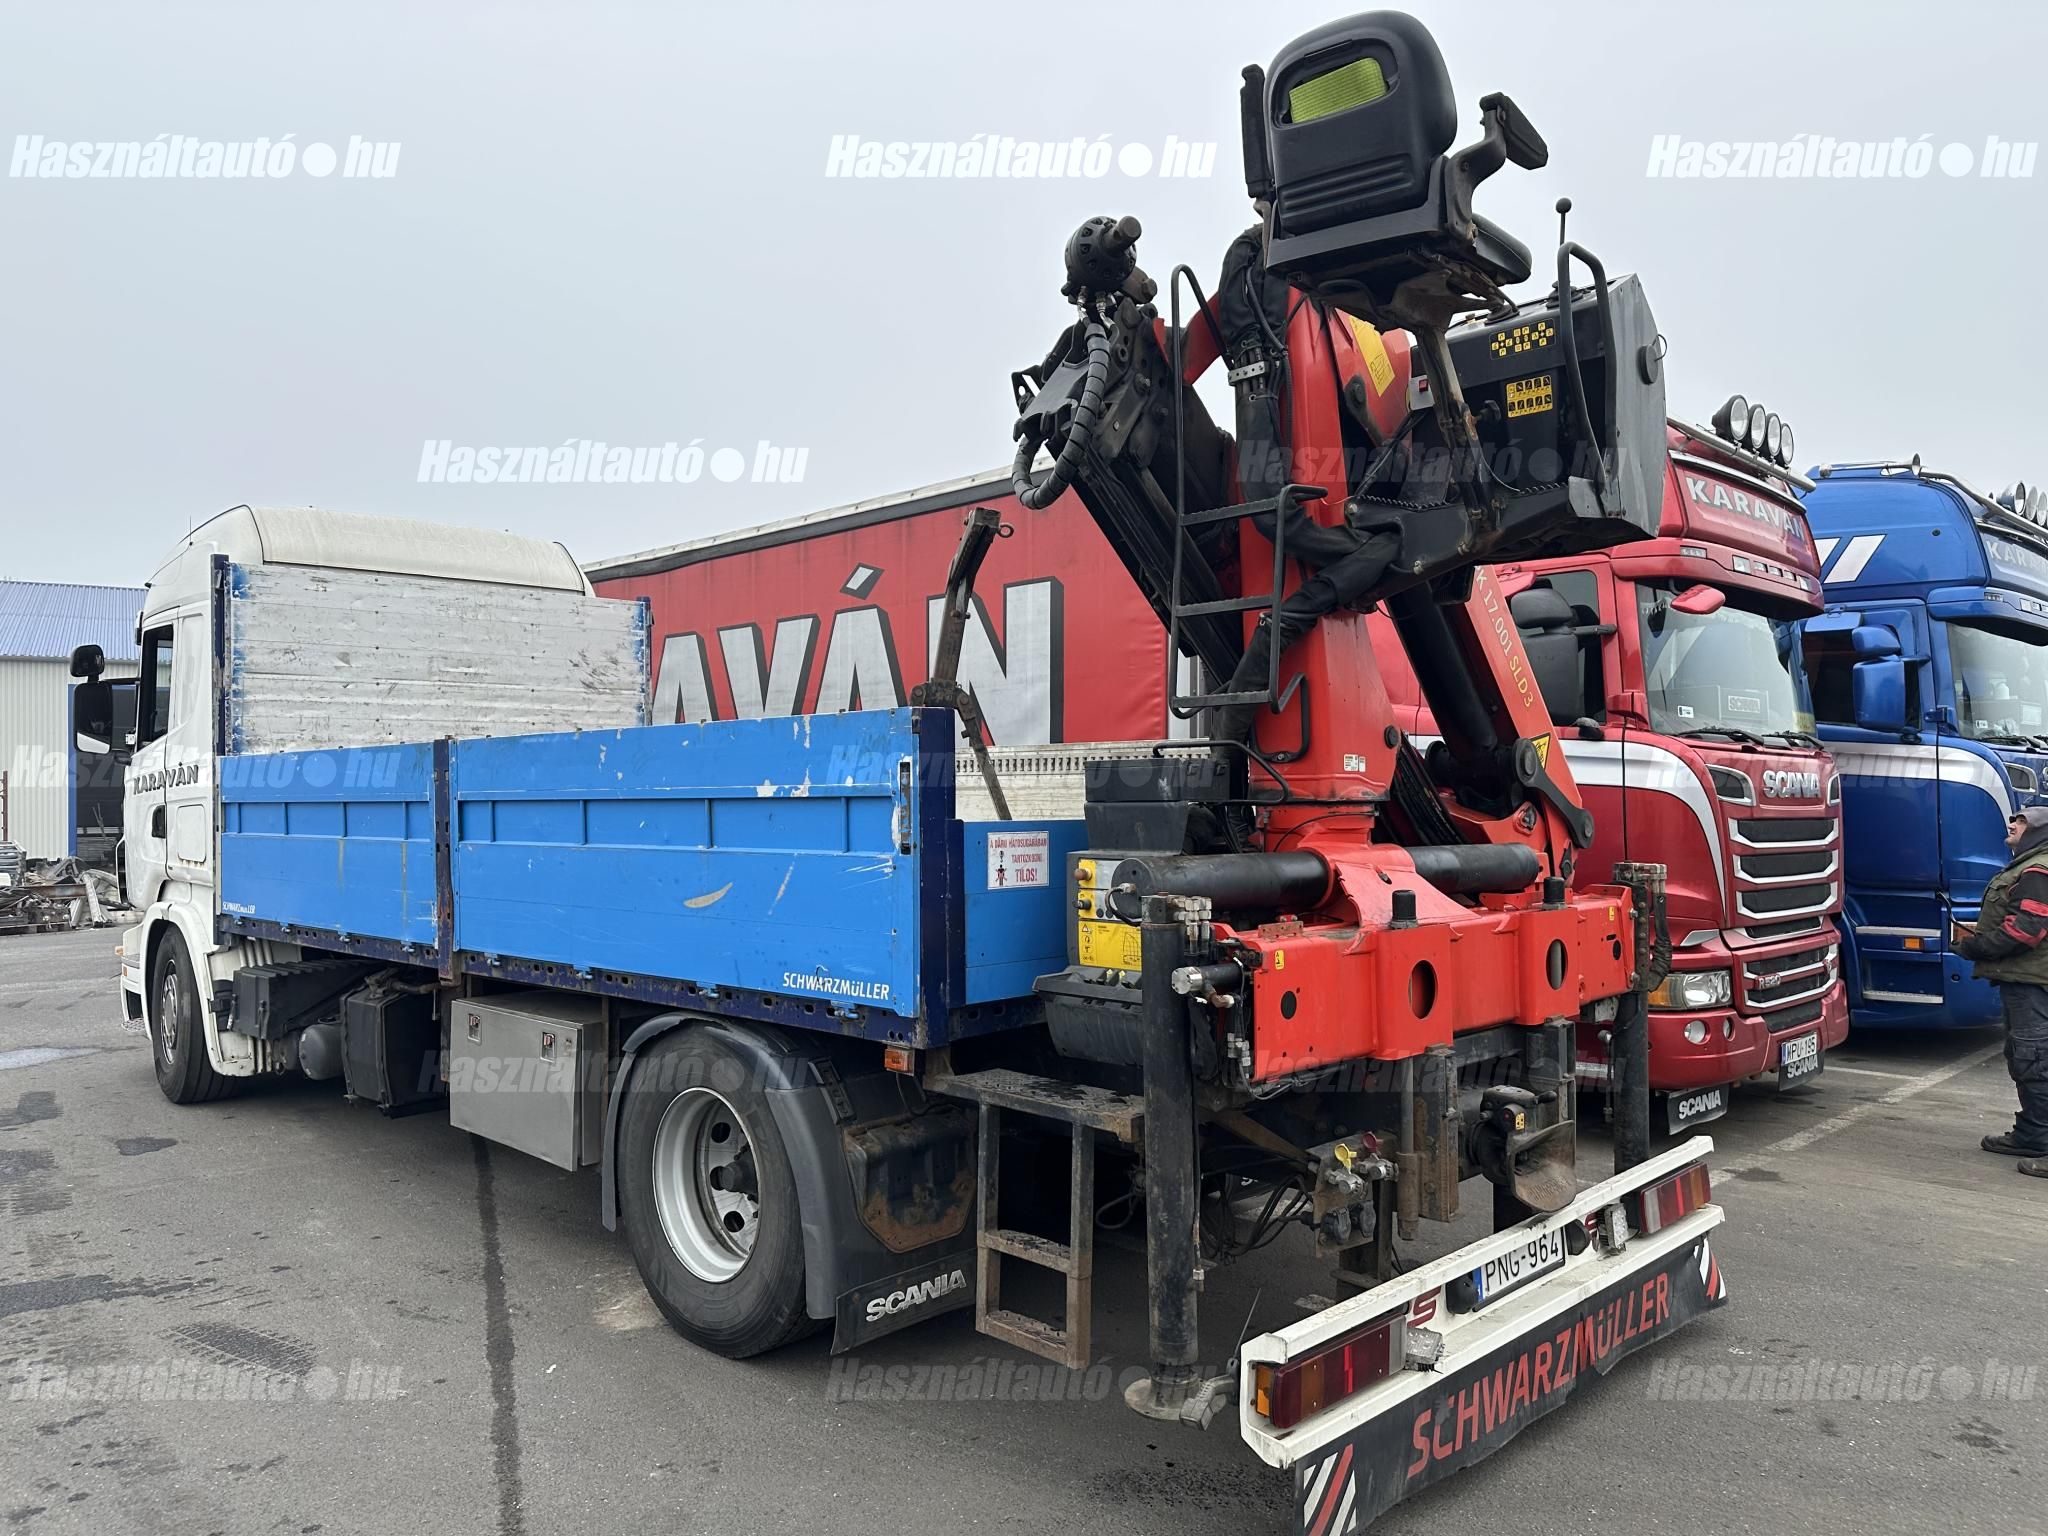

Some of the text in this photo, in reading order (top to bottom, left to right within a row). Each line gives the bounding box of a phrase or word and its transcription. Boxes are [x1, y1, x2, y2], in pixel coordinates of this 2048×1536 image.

[1763, 770, 1821, 798] SCANIA
[1787, 1055, 1818, 1078] SCANIA
[1678, 1090, 1721, 1119] SCANIA
[1485, 1230, 1558, 1292] PNG-964
[866, 1269, 966, 1322] SCANIA
